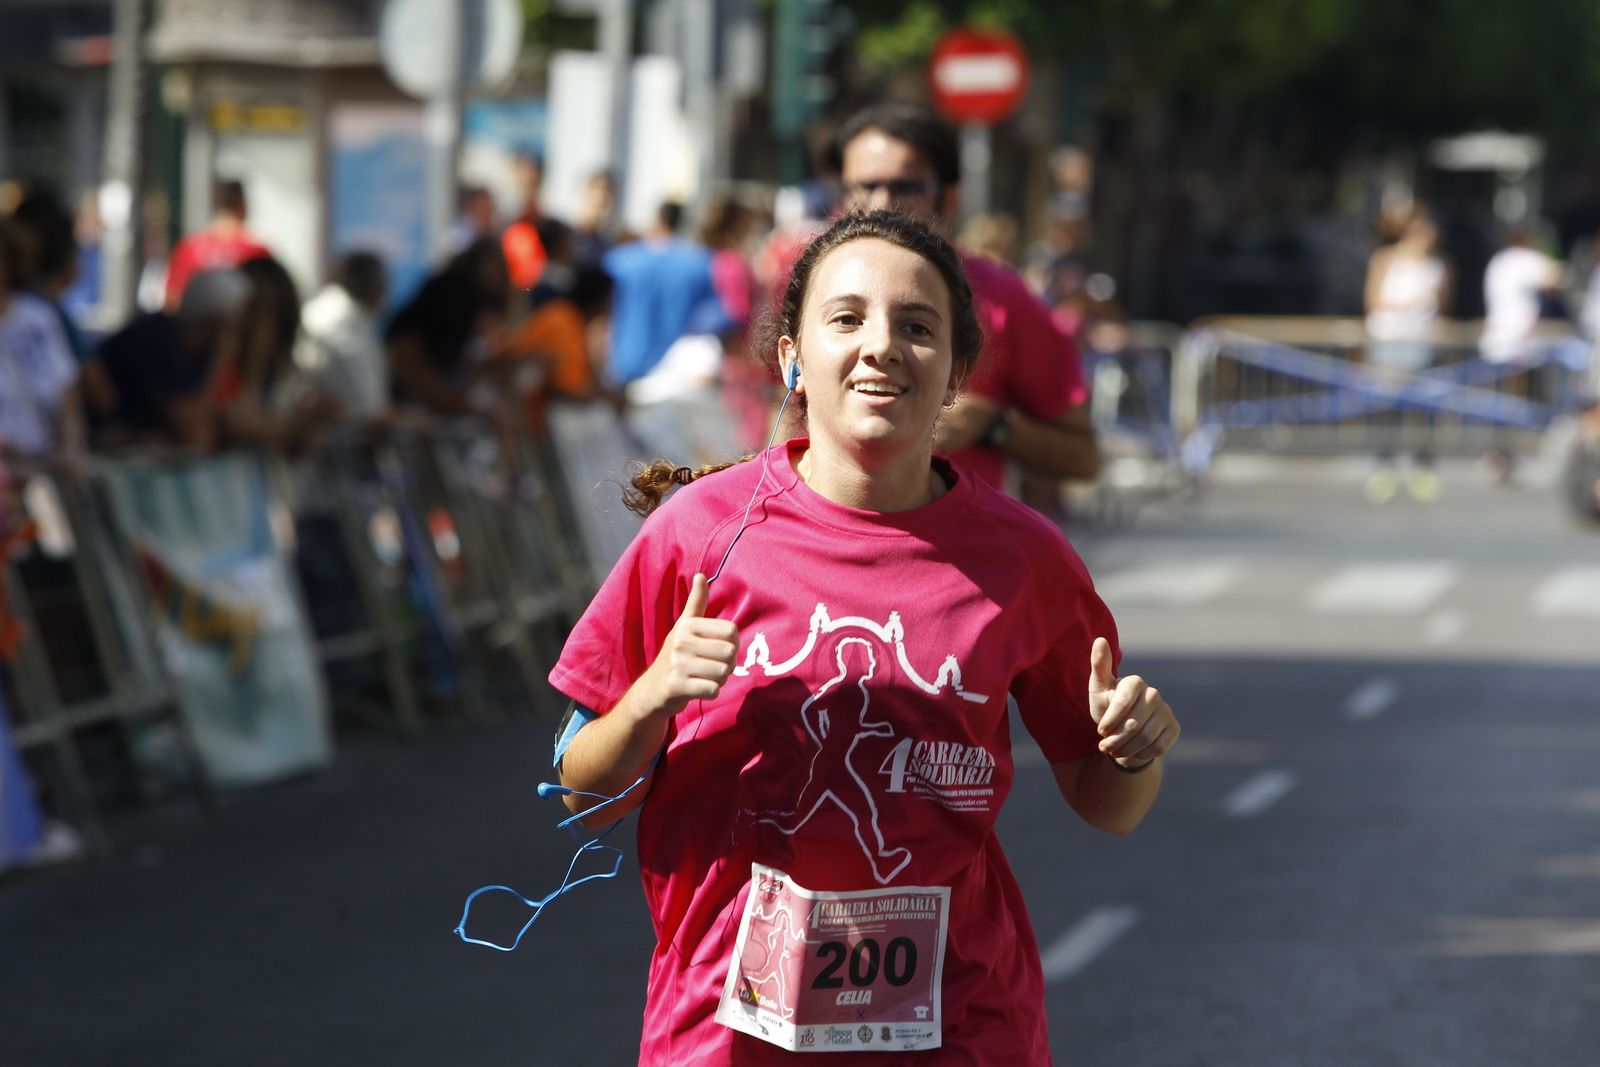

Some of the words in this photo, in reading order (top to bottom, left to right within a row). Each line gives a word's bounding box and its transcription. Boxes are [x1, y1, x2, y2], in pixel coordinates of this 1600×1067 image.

[878, 737, 914, 793] 4
[913, 740, 996, 768] CARRERA
[908, 758, 993, 786] SOLIDARIA
[820, 901, 875, 917] CARRERA
[875, 897, 937, 913] SOLIDARIA
[812, 936, 918, 990] 200
[835, 990, 872, 1006] CELIA
